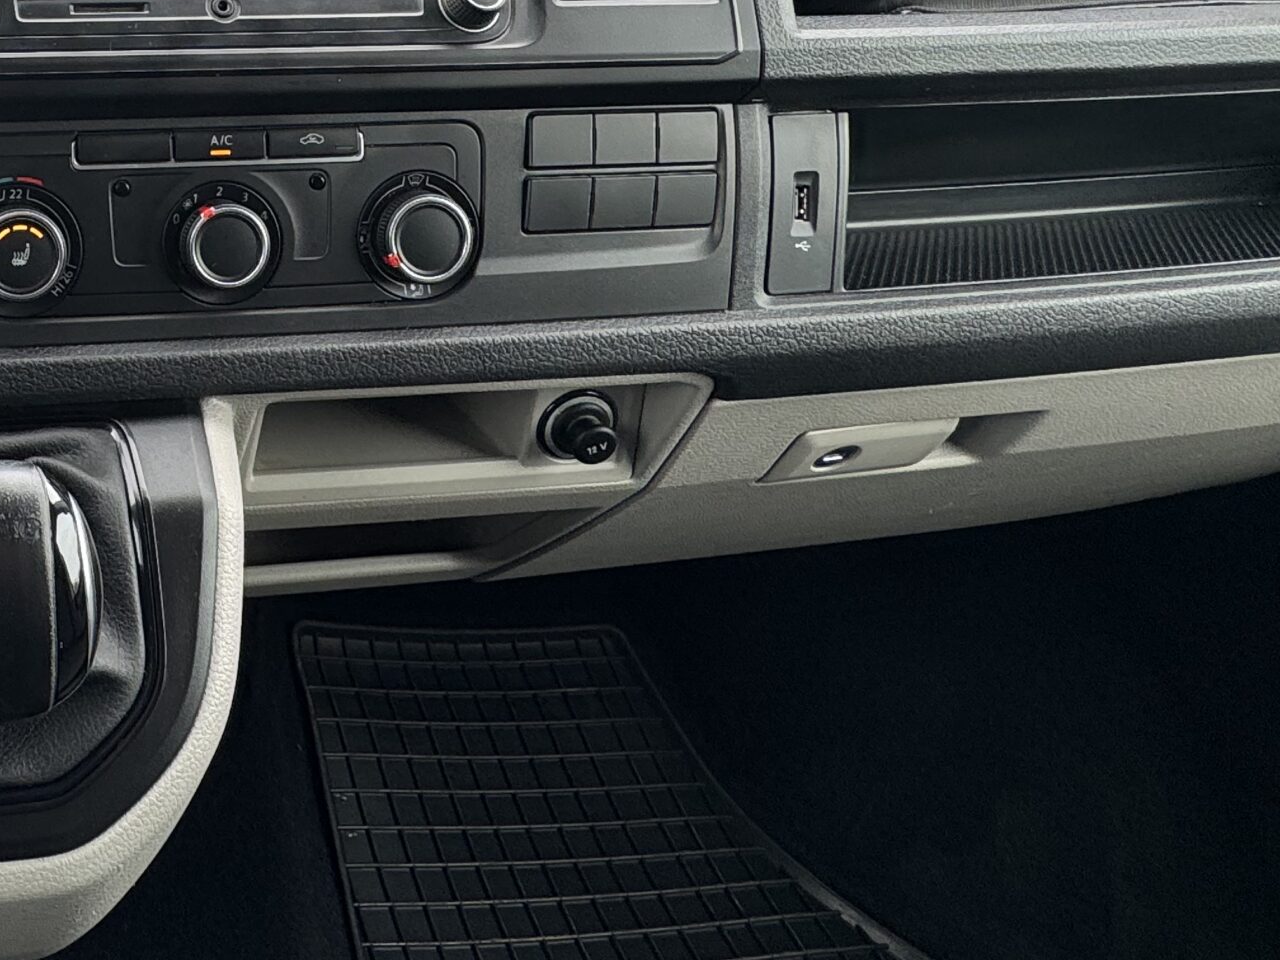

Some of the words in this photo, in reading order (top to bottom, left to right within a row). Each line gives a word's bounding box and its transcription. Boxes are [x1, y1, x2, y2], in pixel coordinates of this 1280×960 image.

[210, 135, 233, 146] A/C
[9, 189, 23, 200] 22
[193, 193, 199, 203] 1
[216, 186, 224, 197] 2
[242, 192, 249, 202] 3
[586, 445, 598, 455] 12
[599, 441, 608, 451] V
